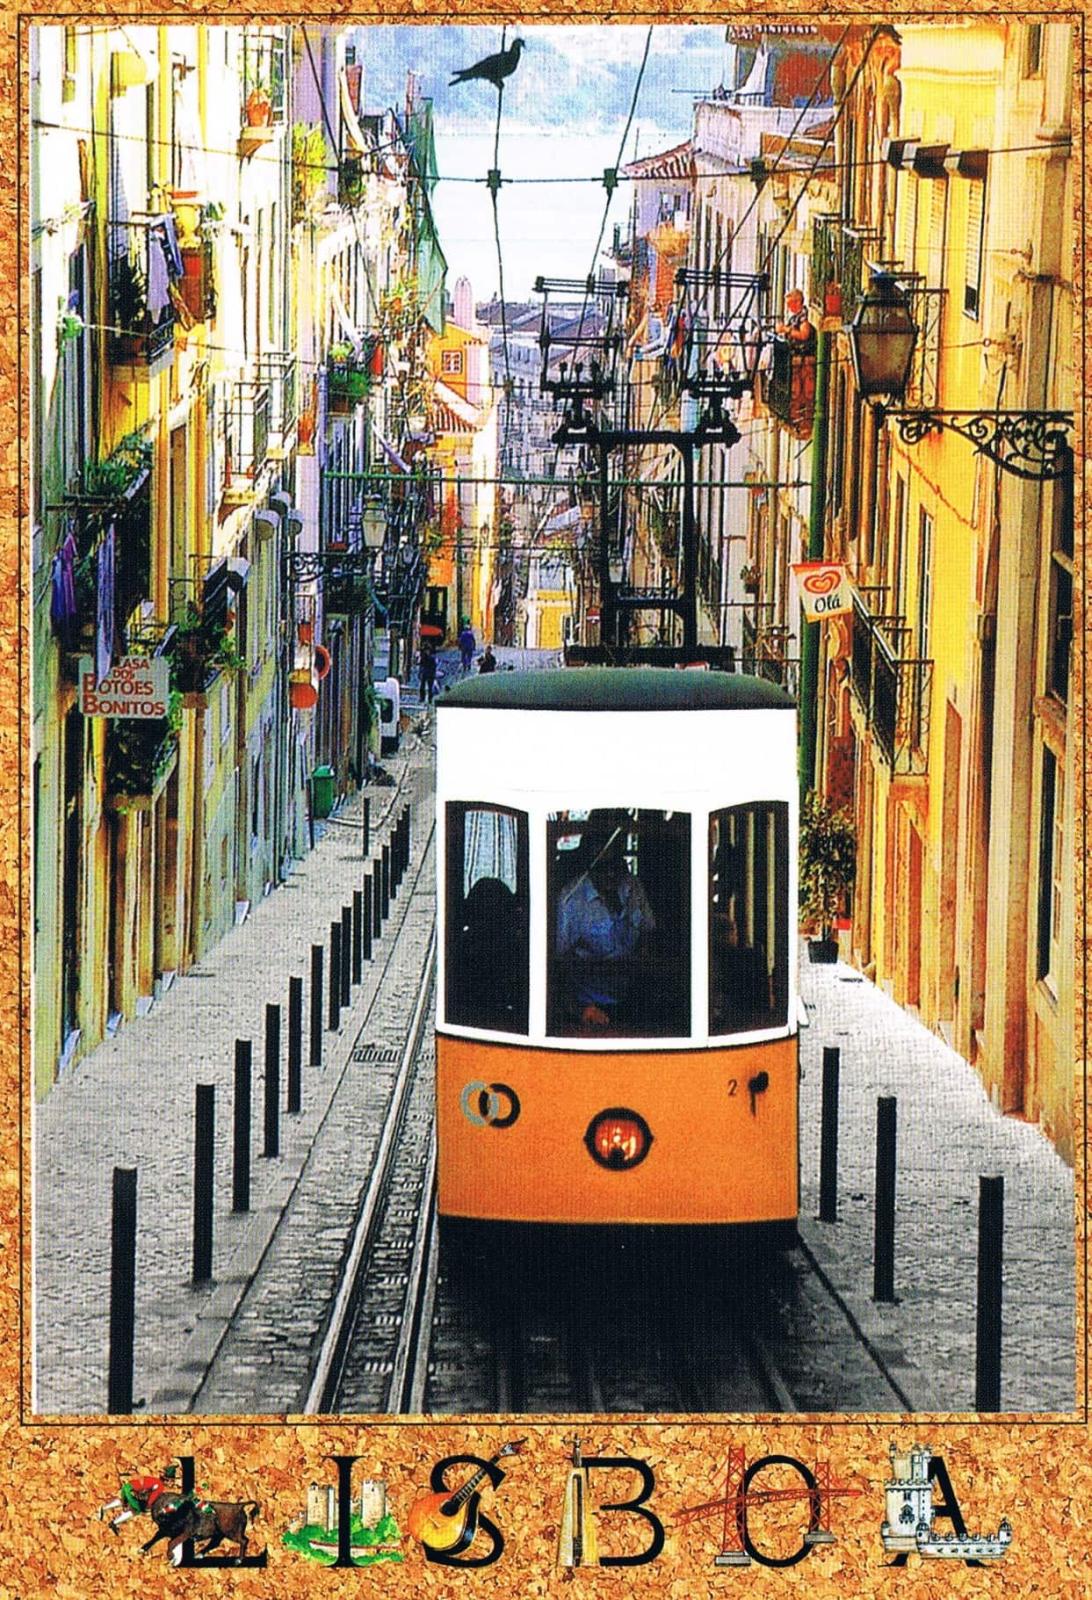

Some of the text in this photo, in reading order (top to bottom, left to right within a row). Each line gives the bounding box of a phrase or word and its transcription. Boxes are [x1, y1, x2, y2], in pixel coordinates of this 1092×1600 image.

[814, 594, 841, 613] Olá
[119, 657, 150, 669] ASA
[83, 694, 165, 716] BONITOS
[727, 1078, 738, 1097] 2
